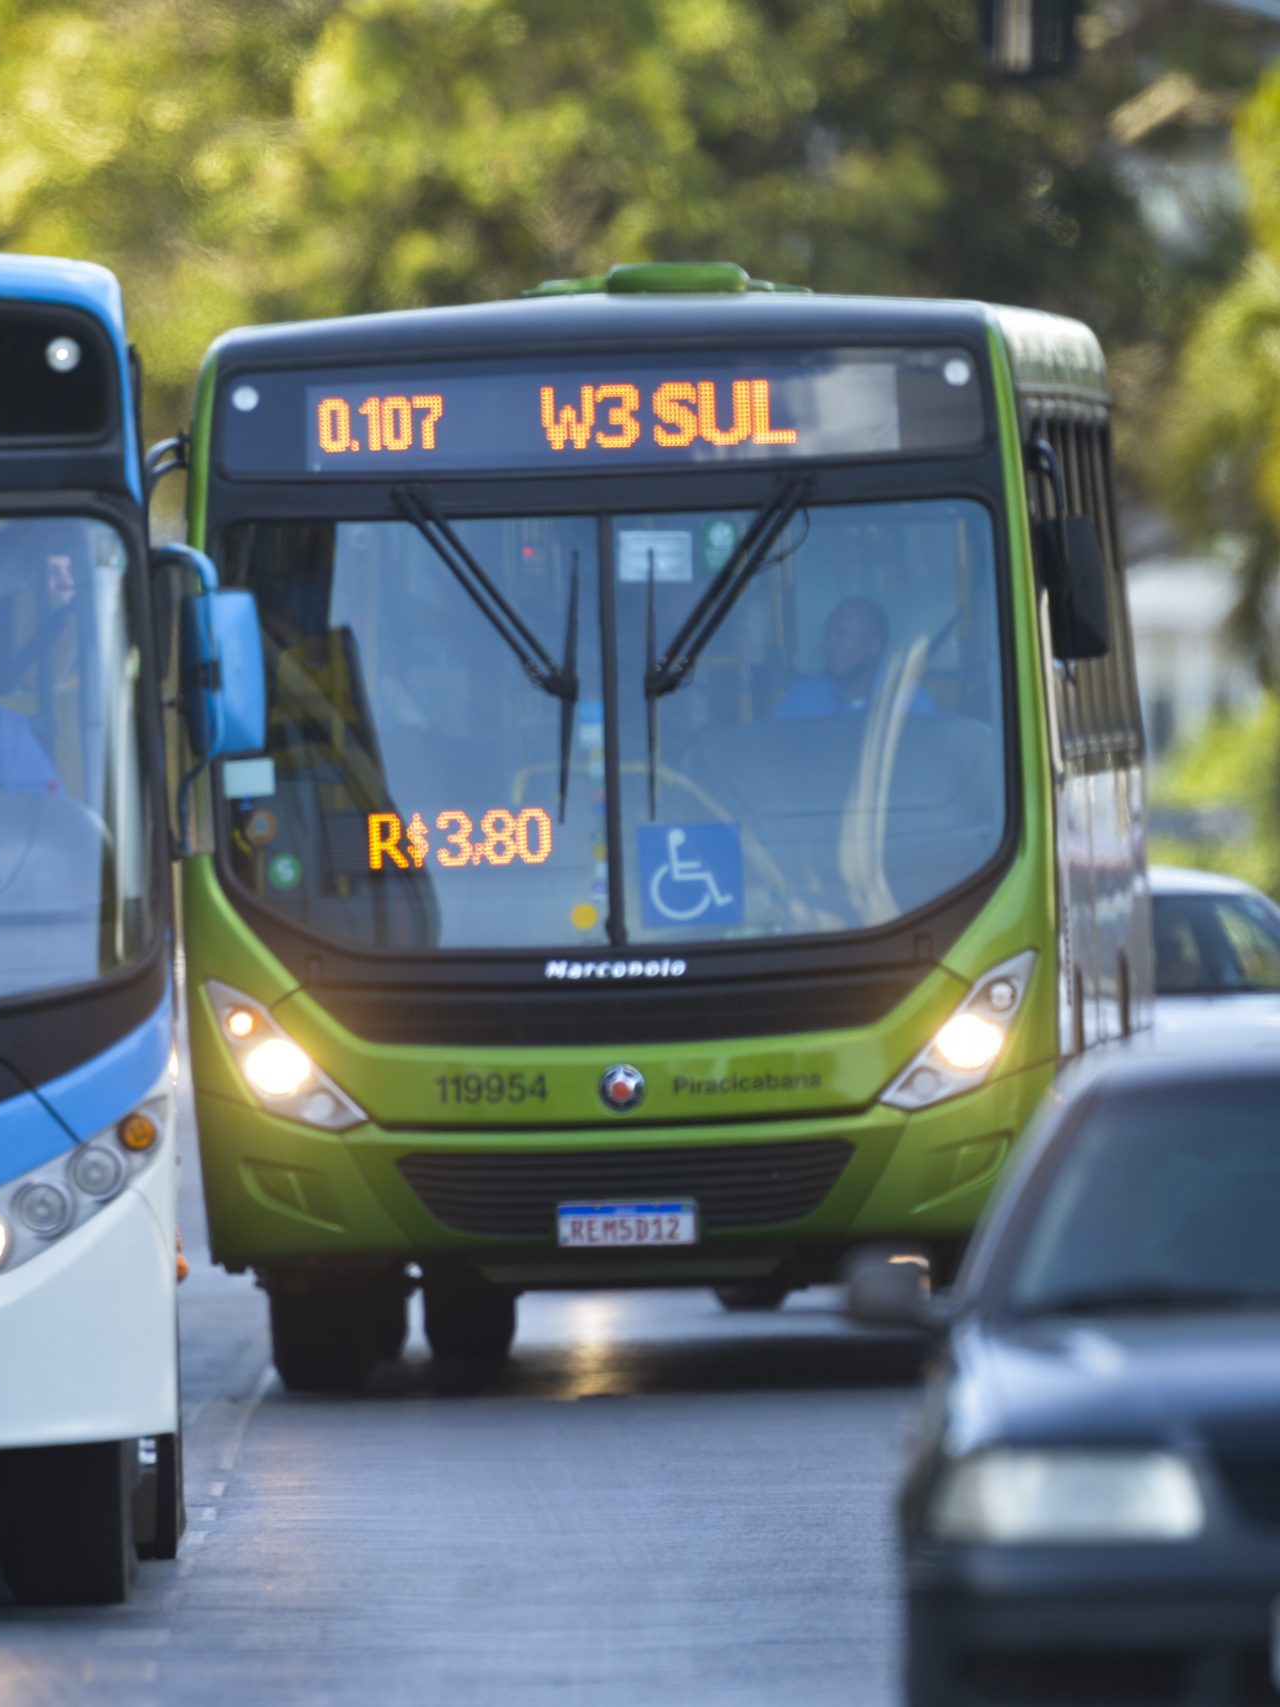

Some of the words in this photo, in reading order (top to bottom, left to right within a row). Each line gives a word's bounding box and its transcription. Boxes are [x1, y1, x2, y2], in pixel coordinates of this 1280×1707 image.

[317, 395, 443, 453] 0.107
[539, 383, 641, 450] W3
[652, 379, 797, 447] SUL
[545, 957, 687, 980] Marcopolo
[434, 1072, 548, 1104] 119954
[673, 1073, 822, 1096] Piracicabana
